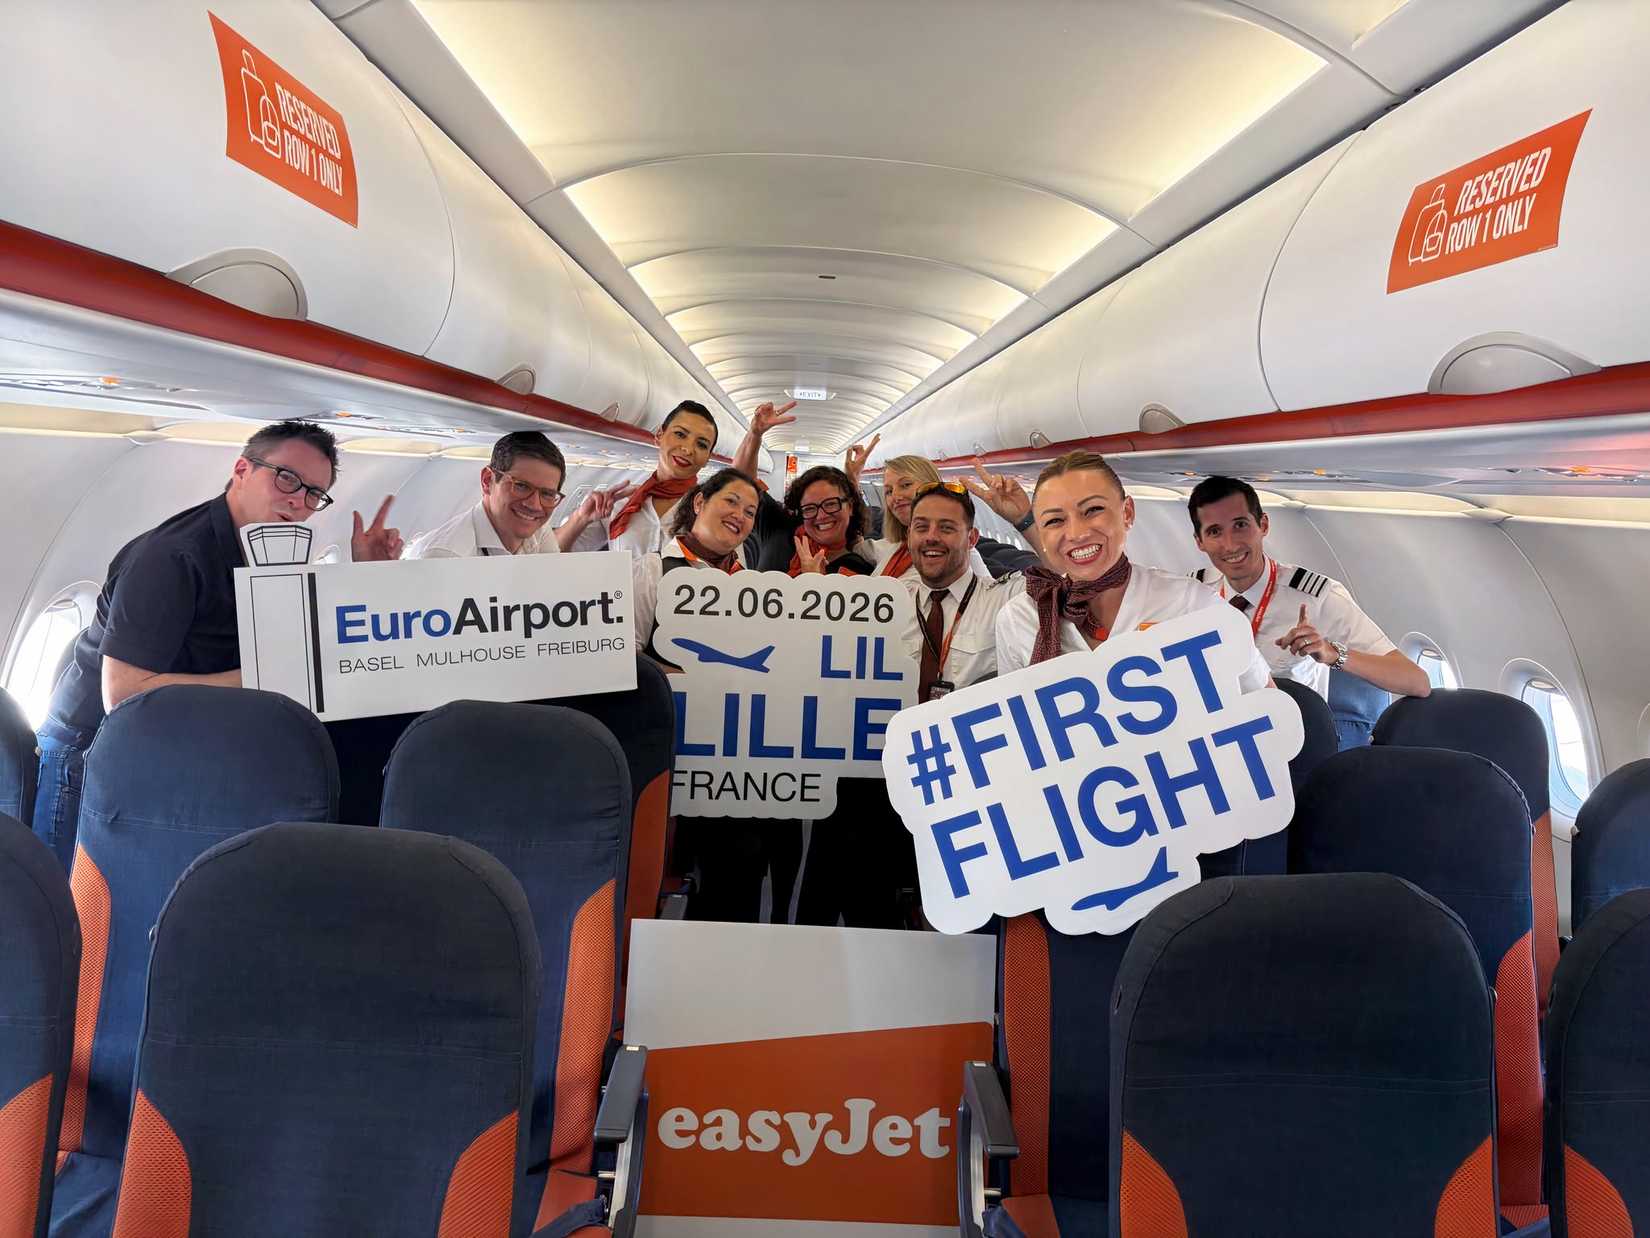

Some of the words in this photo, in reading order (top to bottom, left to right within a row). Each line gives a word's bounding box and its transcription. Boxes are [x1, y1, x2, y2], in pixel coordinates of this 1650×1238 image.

[275, 82, 341, 159] RESERVED
[283, 129, 309, 176] ROW
[311, 149, 317, 181] 1
[319, 153, 343, 196] ONLY
[1454, 147, 1551, 216] RESERVED
[1445, 213, 1483, 254] ROW
[1483, 210, 1492, 243] 1
[1492, 193, 1536, 239] ONLY
[673, 584, 894, 623] 22.06.2026
[339, 656, 404, 674] BASEL
[416, 645, 526, 667] MULHOUSE
[537, 637, 625, 656] FREIBURG
[821, 635, 903, 680] LIL
[672, 691, 902, 760] LILLE
[907, 630, 1224, 805] #FIRST
[931, 715, 1276, 899] FLIGHT
[658, 1098, 951, 1166] easyJet
